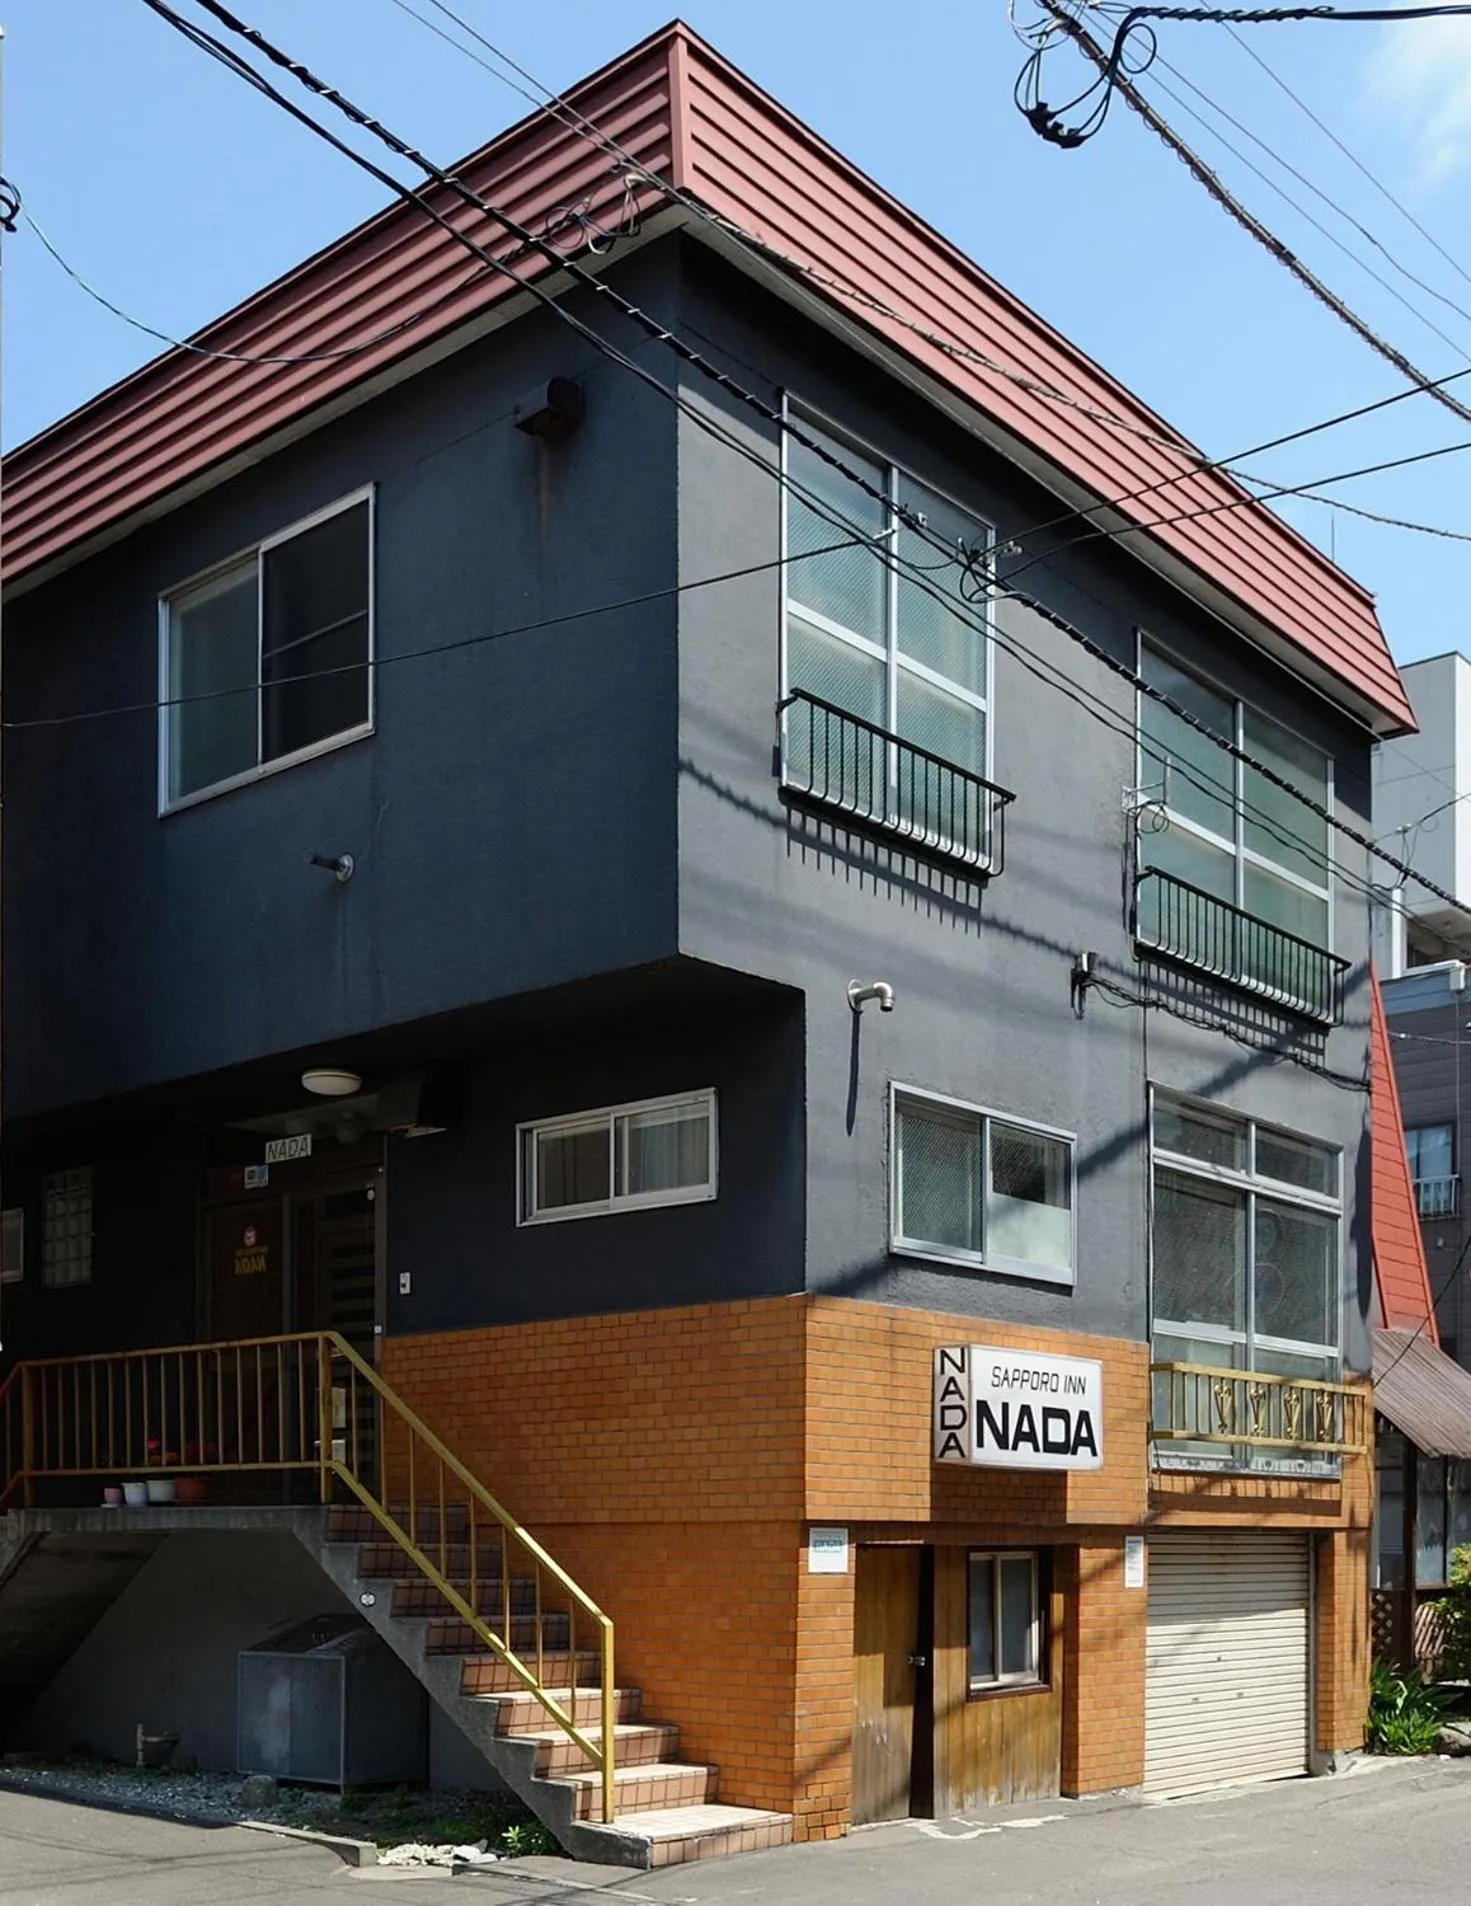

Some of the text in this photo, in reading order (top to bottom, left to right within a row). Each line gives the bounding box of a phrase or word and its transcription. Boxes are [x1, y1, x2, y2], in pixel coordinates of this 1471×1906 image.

[267, 1135, 309, 1160] NADA
[938, 1347, 967, 1459] NADA
[991, 1365, 1087, 1396] SAPPORO INN
[976, 1398, 1099, 1458] NADA
